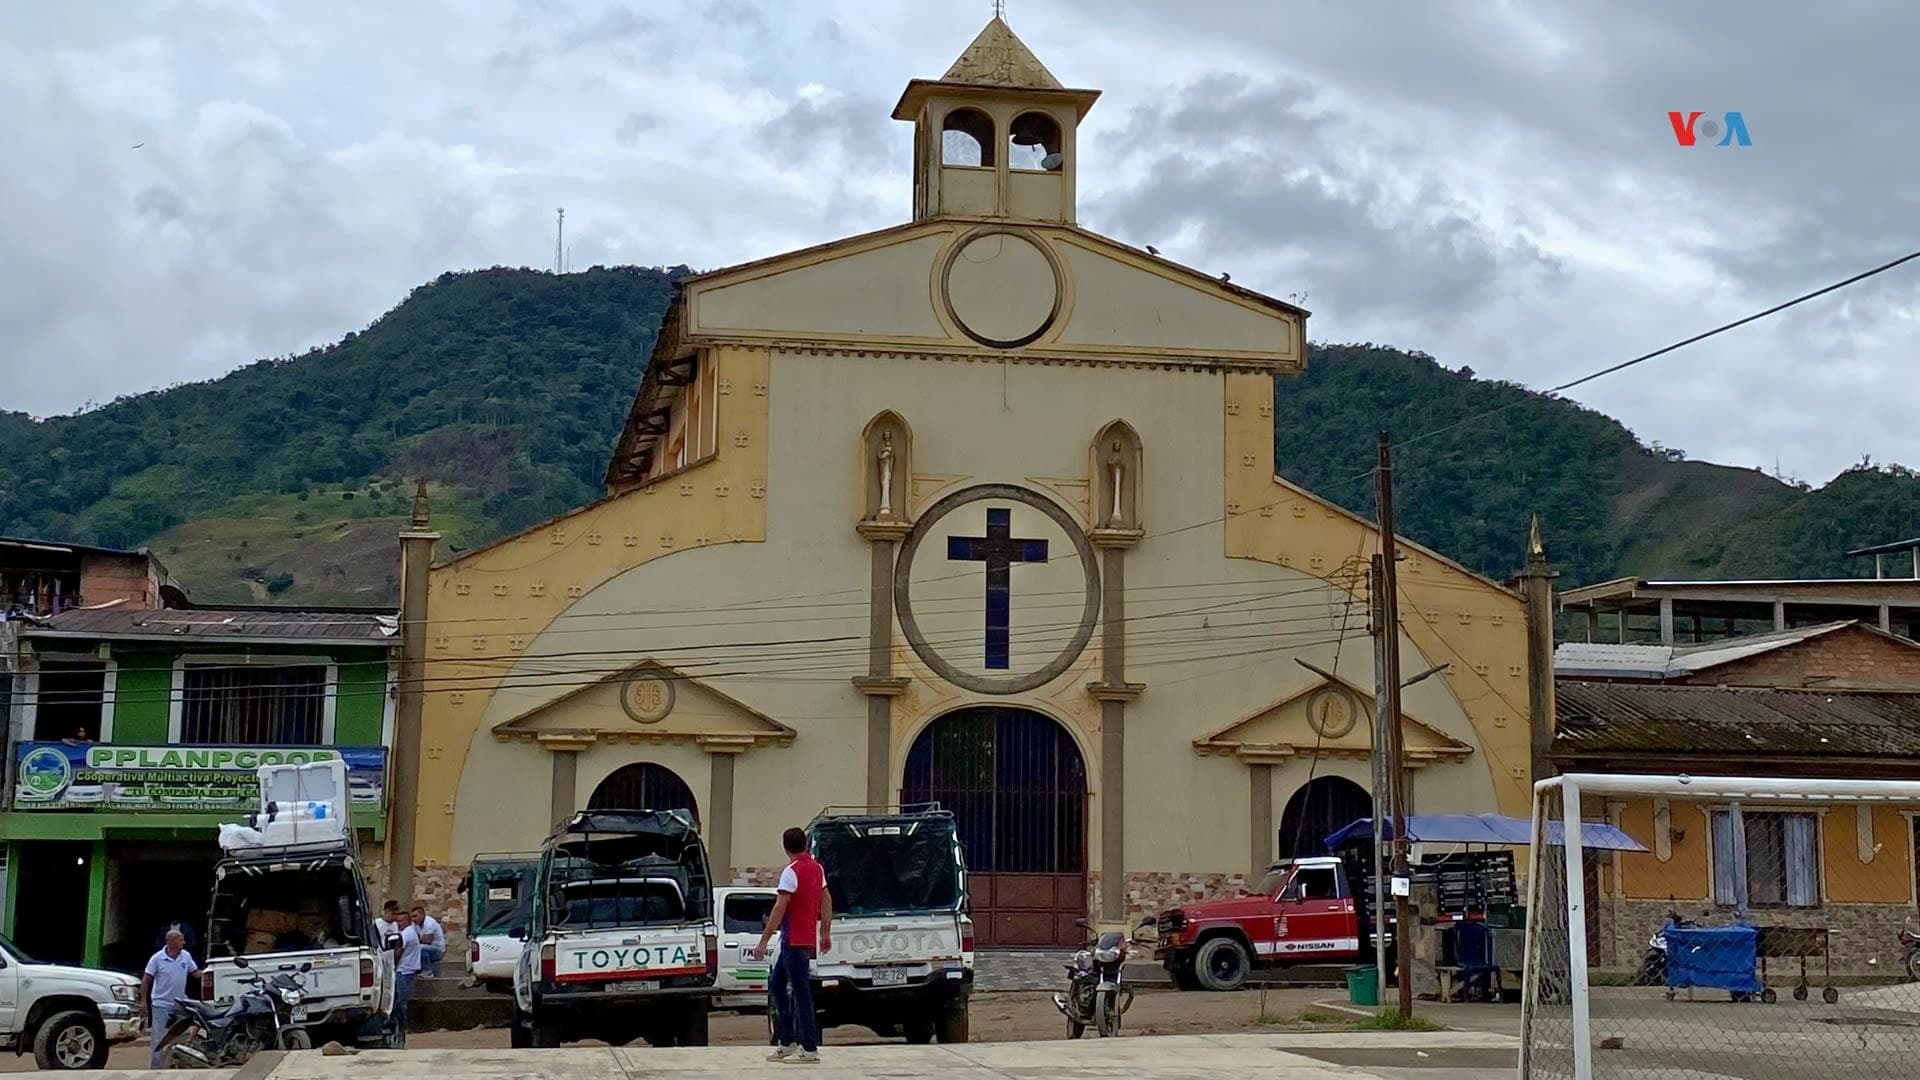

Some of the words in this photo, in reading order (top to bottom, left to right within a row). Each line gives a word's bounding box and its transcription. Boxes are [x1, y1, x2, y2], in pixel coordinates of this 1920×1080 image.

[76, 772, 144, 783] Cooperativa
[147, 772, 210, 783] Multiactiva
[833, 932, 946, 953] TOYOTA
[1297, 942, 1335, 950] NISSAN
[573, 946, 687, 969] TOYOTA
